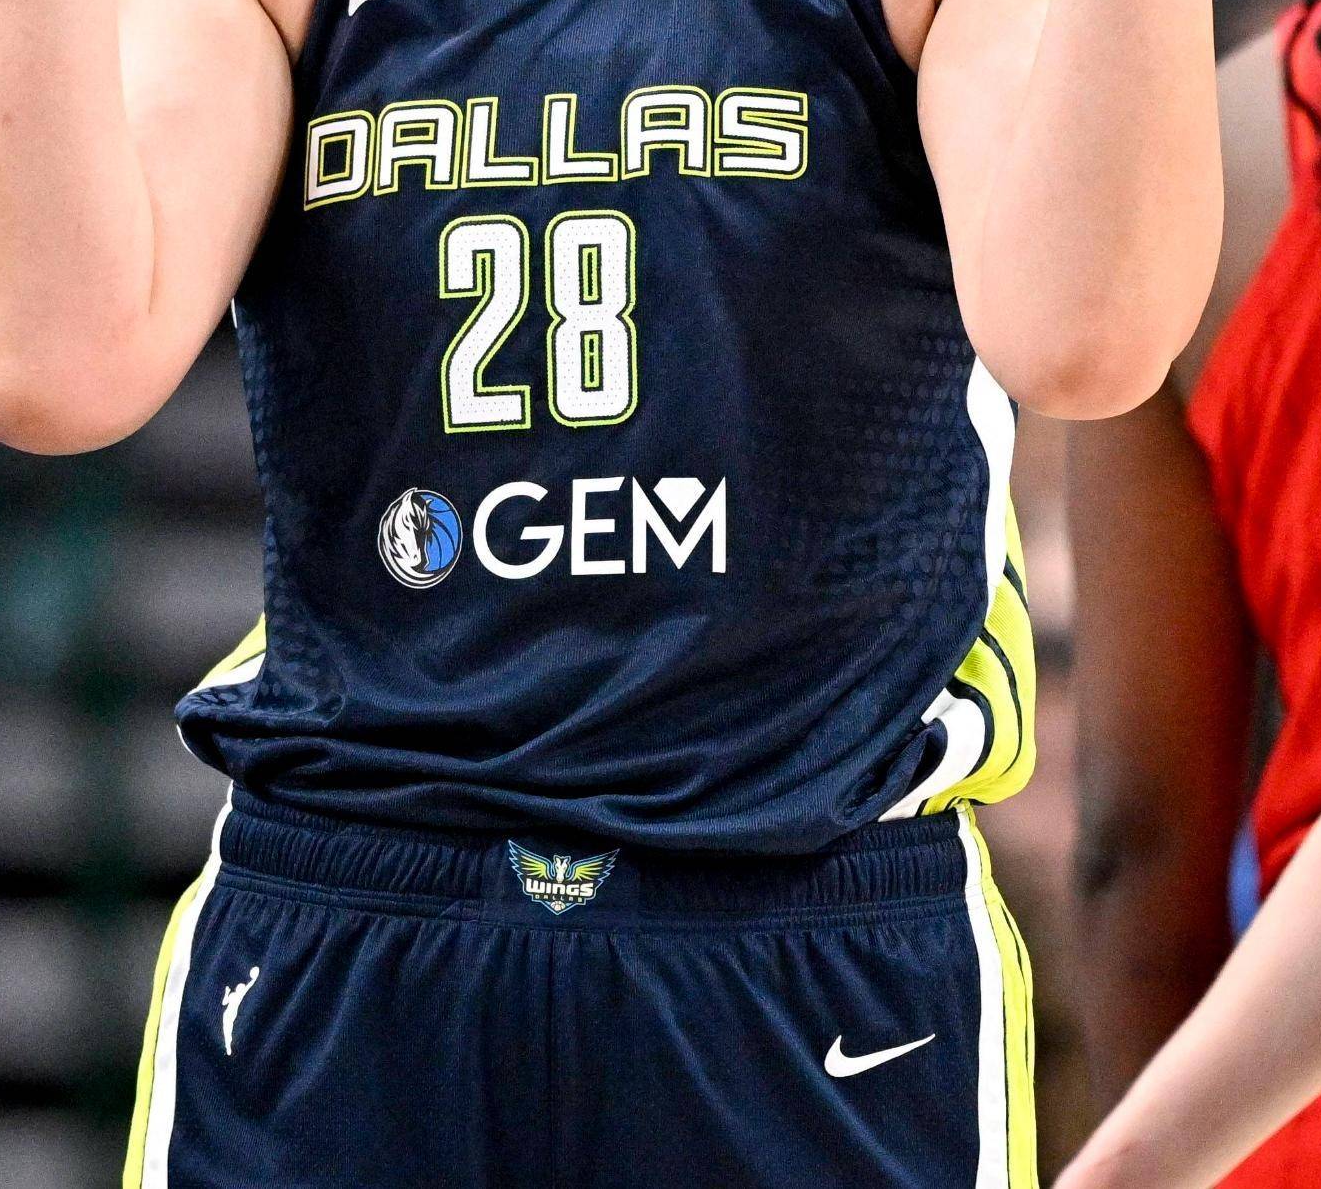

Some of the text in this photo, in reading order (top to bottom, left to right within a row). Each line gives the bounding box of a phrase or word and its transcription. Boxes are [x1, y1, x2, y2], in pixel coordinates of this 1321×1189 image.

[304, 85, 809, 211] DALLAS
[439, 210, 637, 434] 28
[473, 476, 727, 576] GEM
[525, 878, 594, 897] WINGS
